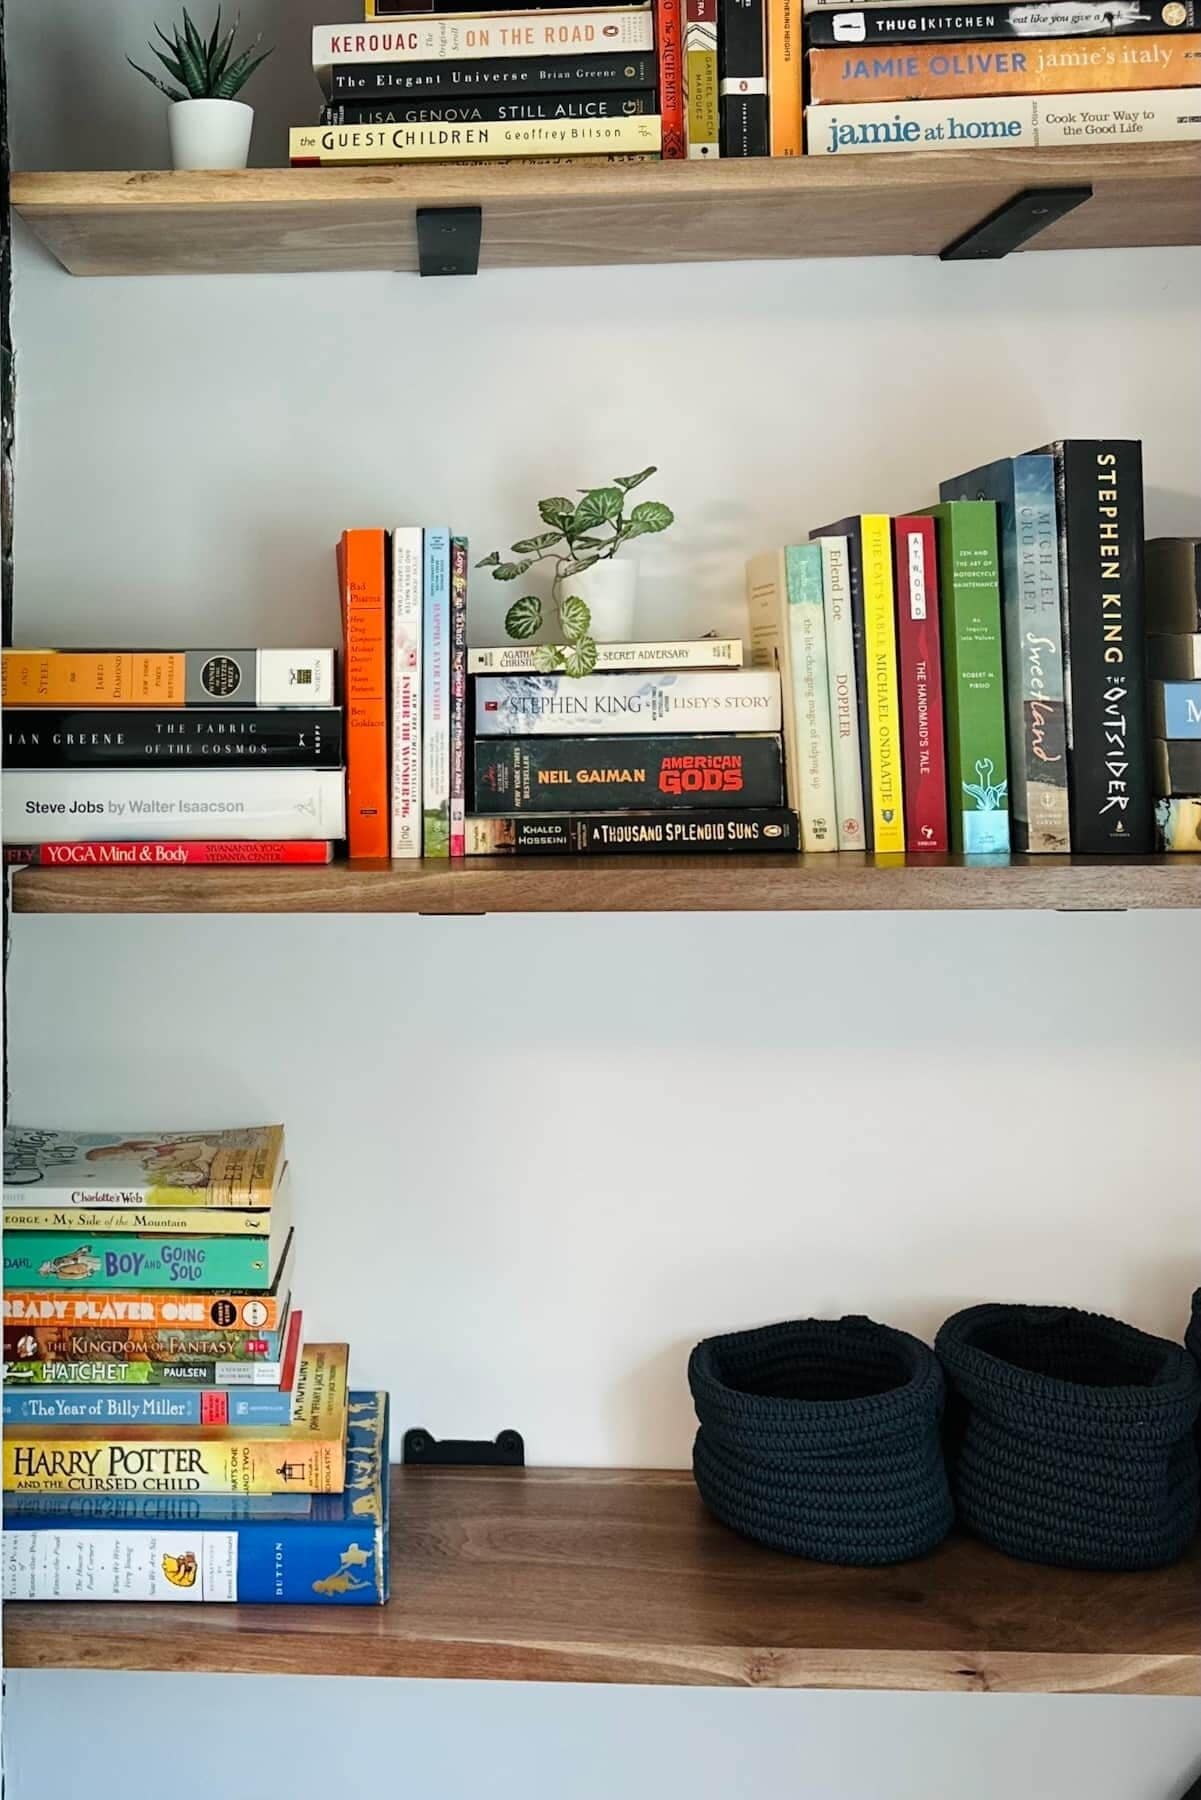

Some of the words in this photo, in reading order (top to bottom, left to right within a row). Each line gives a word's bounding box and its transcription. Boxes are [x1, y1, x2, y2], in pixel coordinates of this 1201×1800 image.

[876, 19, 917, 32] THUG
[928, 16, 995, 30] KITCHEN
[1012, 15, 1028, 24] eat
[1030, 13, 1048, 24] like
[1049, 15, 1069, 27] you
[330, 33, 418, 53] KEROUAC
[466, 30, 490, 47] ON
[500, 27, 535, 45] THE
[545, 24, 595, 43] ROAD
[841, 56, 920, 80] JAMIE
[929, 53, 1028, 76] OLIVER
[1035, 46, 1116, 74] jamie's
[1118, 43, 1174, 69] italy
[336, 76, 367, 88] The
[376, 73, 441, 88] Elegant
[452, 70, 529, 84] Universe
[539, 69, 571, 80] Brian
[576, 67, 617, 79] Greene
[663, 34, 677, 111] ALCHEMIST
[705, 56, 713, 98] GABRIEL
[405, 107, 482, 122] GENOVA
[498, 104, 547, 119] STILL
[554, 101, 608, 117] ALICE
[1045, 113, 1077, 125] Cook
[1079, 111, 1111, 123] Your
[1112, 110, 1140, 125] Way
[1143, 110, 1155, 120] to
[300, 136, 316, 147] the
[321, 131, 386, 150] GUEST
[392, 129, 489, 149] CHILDREN
[504, 128, 566, 141] Geoffrey
[571, 127, 621, 139] Bilson
[826, 114, 921, 153] jamie
[924, 127, 945, 141] at
[946, 117, 1023, 139] home
[1063, 125, 1083, 136] the
[1084, 123, 1117, 135] Good
[1119, 122, 1144, 134] Life
[1097, 453, 1121, 579] STEPHEN
[455, 550, 465, 574] Love
[829, 549, 844, 592] Erlend
[1037, 510, 1055, 613] MICHAEL
[831, 597, 844, 622] Loe
[1102, 593, 1124, 664] KING
[500, 659, 535, 668] CHRISTI
[603, 651, 636, 661] SECRET
[638, 649, 690, 660] ADVERSARY
[39, 661, 49, 696] STEEL
[96, 663, 105, 691] JARED
[112, 655, 122, 699] DIAMOND
[916, 661, 927, 682] THE
[1105, 676, 1127, 685] THE
[876, 653, 890, 722] MICHAEL
[509, 695, 589, 714] STEPHEN
[595, 695, 642, 713] KING
[673, 695, 721, 709] LISEY'S
[724, 695, 773, 708] STORY
[836, 674, 852, 739] DOPPLER
[917, 684, 930, 747] HANDMAID'S
[8, 733, 40, 745] IAN
[52, 733, 126, 745] GREENE
[155, 723, 186, 734] THE
[196, 723, 257, 734] FABRIC
[144, 744, 162, 754] OF
[167, 744, 193, 754] THE
[201, 743, 269, 754] COSMOS
[1099, 686, 1130, 815] OUTSIDER
[402, 747, 411, 795] WONDER
[879, 726, 893, 804] ONDAATJE
[920, 750, 931, 775] TALE
[522, 754, 530, 799] BESTSELLER
[537, 769, 573, 785] NEIL
[575, 768, 646, 785] GAIMAN
[658, 769, 744, 795] GODS
[25, 800, 66, 814] Steve
[69, 800, 105, 814] Jobs
[108, 800, 126, 816] by
[129, 800, 178, 814] Walter
[178, 800, 245, 814] Isaacson
[518, 836, 567, 845] HOSSEINI
[522, 825, 562, 835] KHALED
[592, 828, 600, 840] A
[601, 825, 663, 843] THOUSAND
[665, 822, 725, 841] SPLENDID
[727, 821, 760, 840] SUNS
[47, 846, 97, 862] YOGA
[99, 845, 137, 862] Mind
[138, 846, 152, 862] &
[155, 844, 189, 864] Body
[71, 1190, 121, 1203] Charlotte's
[120, 1190, 143, 1203] Web
[4, 1215, 41, 1224] EORGE
[53, 1213, 73, 1226] My
[77, 1214, 100, 1226] Side
[104, 1215, 114, 1229] of
[115, 1215, 128, 1226] the
[134, 1215, 188, 1227] Mountain
[3, 1258, 32, 1269] DAHL
[105, 1251, 145, 1278] BOY
[144, 1259, 162, 1270] AND
[161, 1245, 206, 1264] GOING
[169, 1262, 202, 1282] SOLO
[74, 1300, 155, 1320] PLAYER
[161, 1302, 206, 1321] ONE
[47, 1341, 68, 1351] THE
[72, 1336, 148, 1354] KINGDOM
[151, 1342, 164, 1351] OF
[169, 1336, 236, 1354] FANTASY
[42, 1363, 129, 1380] HATCHET
[163, 1367, 207, 1378] PAULSEN
[28, 1399, 55, 1416] The
[55, 1399, 88, 1416] Year
[88, 1399, 103, 1416] of
[107, 1399, 140, 1418] Billy
[142, 1399, 185, 1416] Miller
[13, 1446, 103, 1477] HARRY
[108, 1446, 209, 1477] POTTER
[230, 1447, 238, 1468] ONE
[242, 1447, 250, 1471] TWO
[16, 1480, 41, 1489] AND
[43, 1480, 64, 1489] THE
[67, 1478, 138, 1491] CURSED
[142, 1478, 201, 1491] CHILD
[275, 1542, 284, 1596] DUTTON
